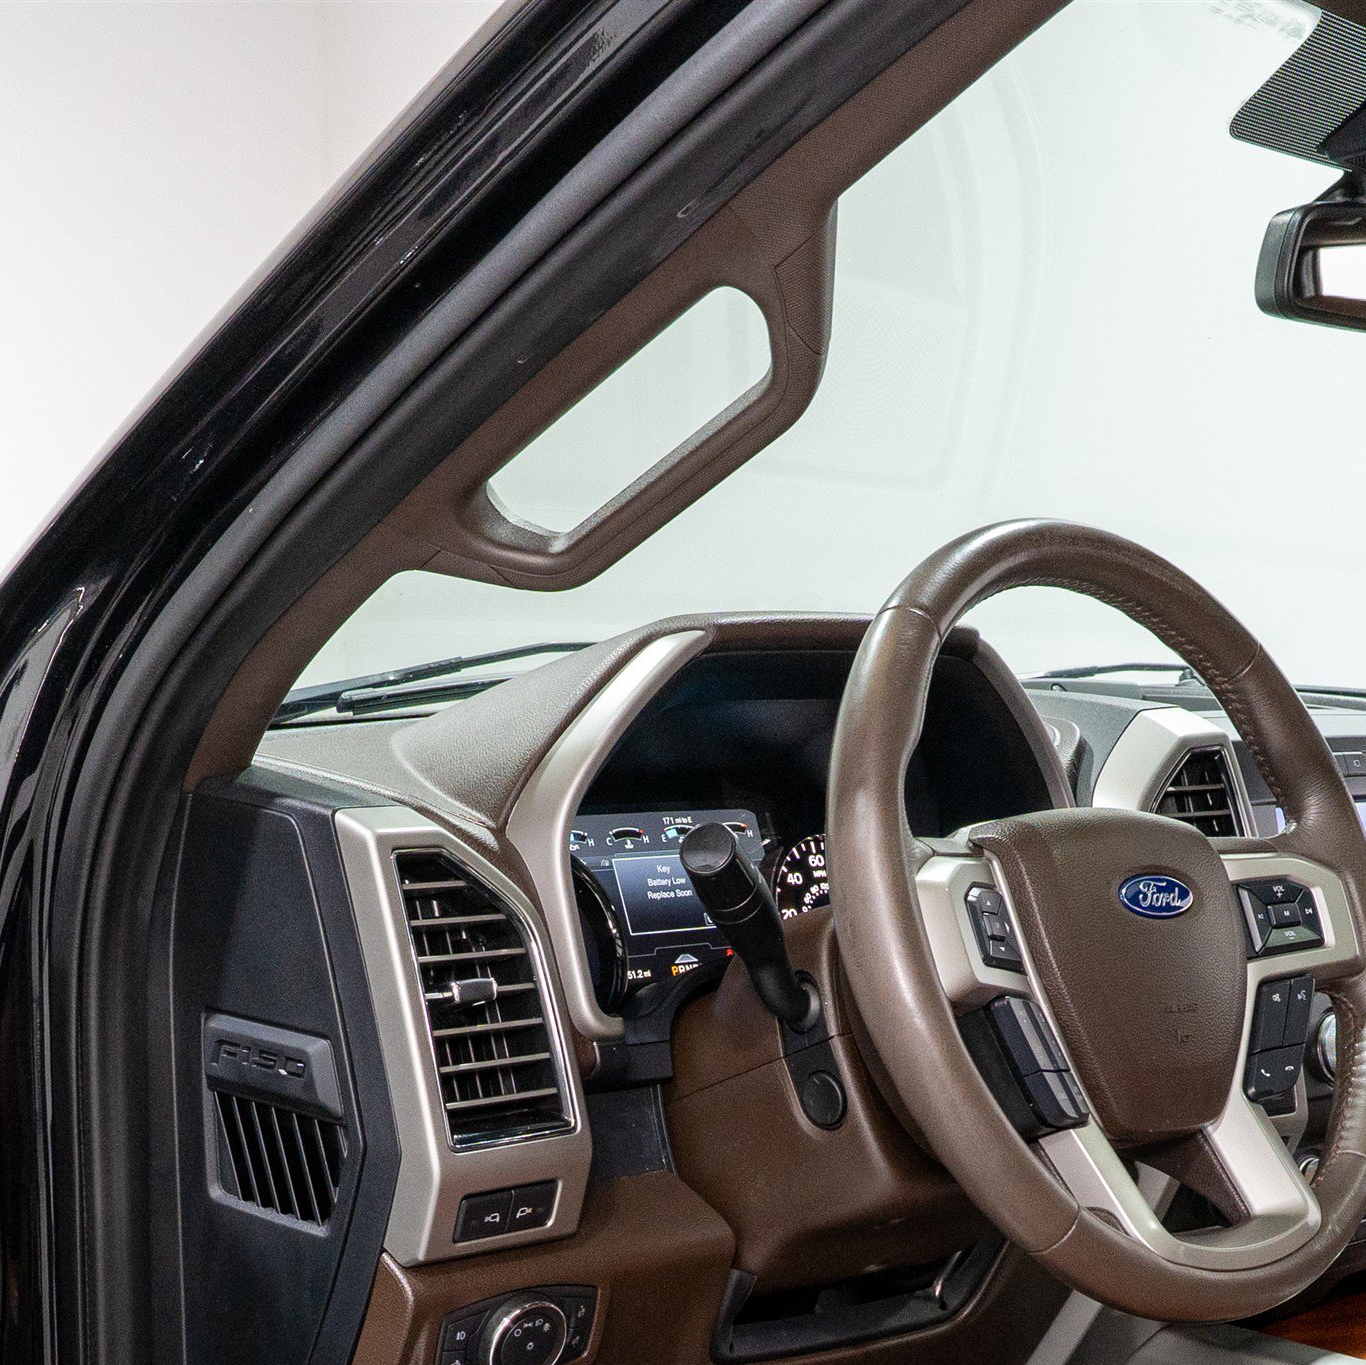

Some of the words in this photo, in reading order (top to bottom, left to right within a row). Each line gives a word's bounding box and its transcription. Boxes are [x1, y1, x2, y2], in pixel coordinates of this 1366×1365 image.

[808, 854, 825, 867] 60
[657, 864, 670, 874] Key
[647, 878, 671, 887] Battery
[672, 877, 685, 885] Low
[787, 872, 803, 885] 40
[647, 890, 675, 900] Replace
[675, 888, 693, 898] Soon
[1139, 880, 1181, 907] Ford
